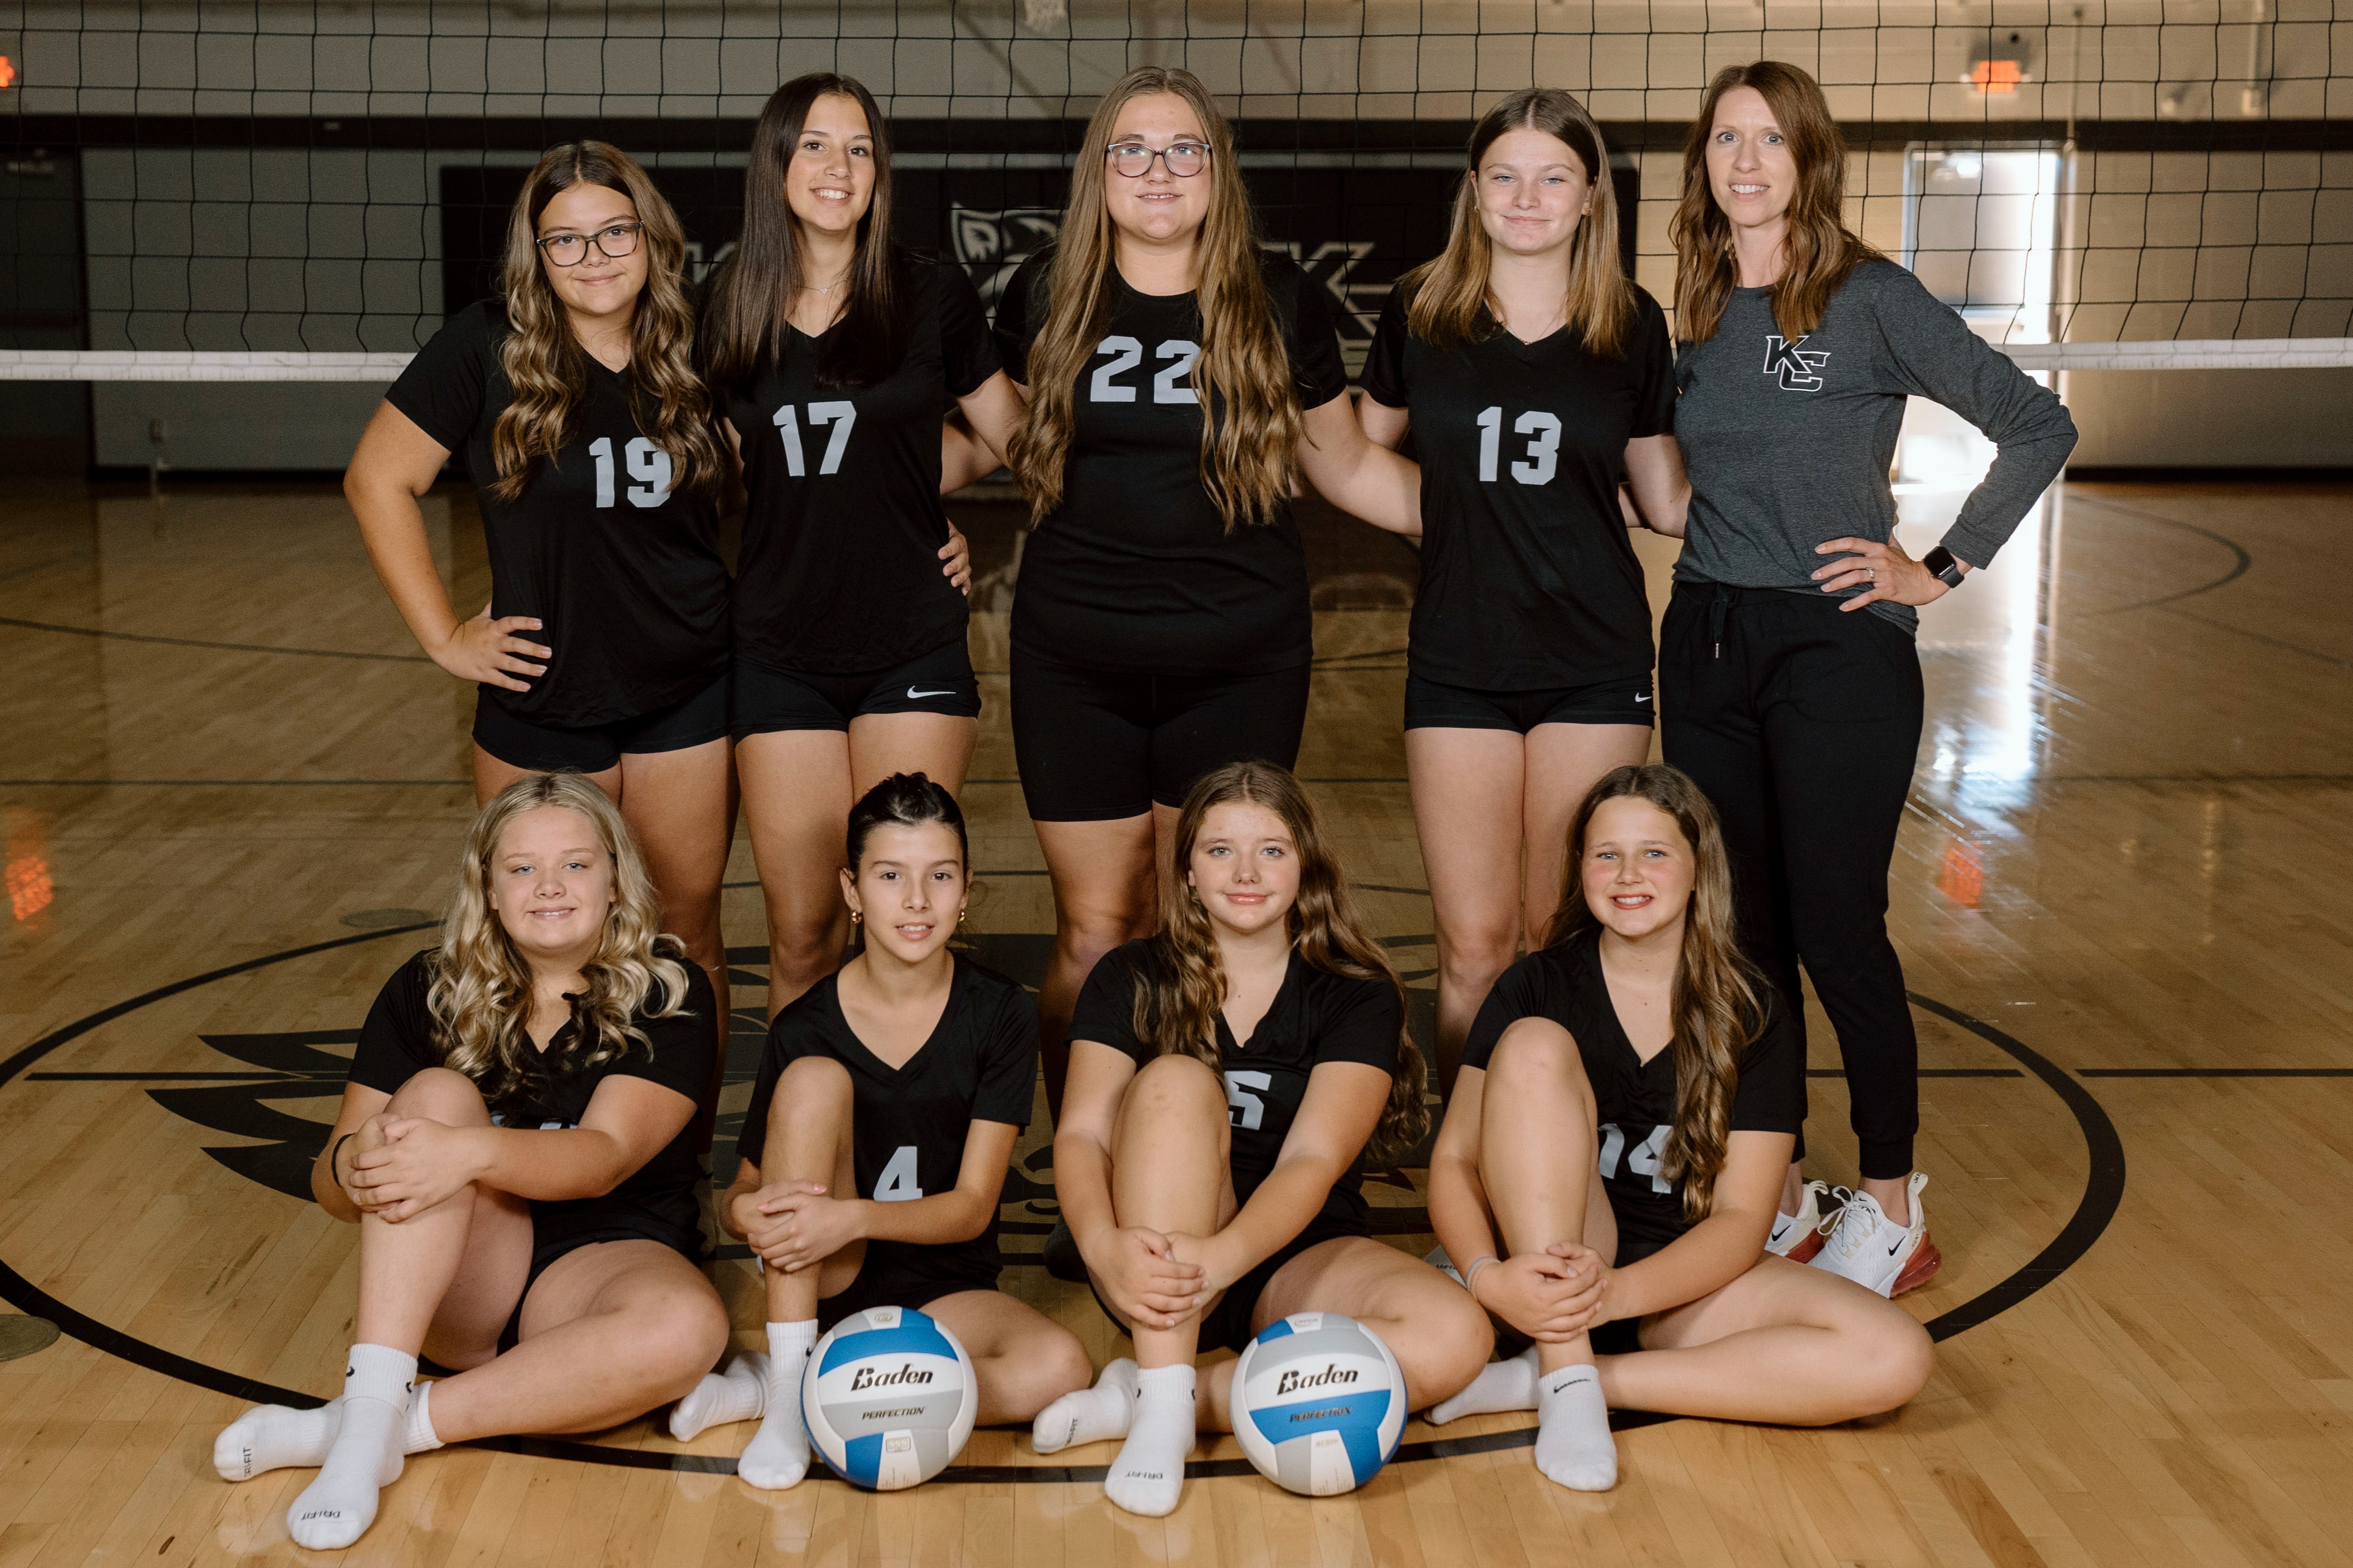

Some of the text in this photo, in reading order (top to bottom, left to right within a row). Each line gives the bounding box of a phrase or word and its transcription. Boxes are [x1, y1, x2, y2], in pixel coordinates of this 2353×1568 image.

[1090, 335, 1202, 404] 22
[1763, 335, 1832, 392] KC
[772, 401, 857, 477] 17
[1477, 406, 1562, 485] 13
[589, 437, 672, 508] 19
[1224, 1070, 1272, 1131] 5
[873, 1145, 923, 1202] 4
[1597, 1123, 1674, 1194] 14
[850, 1362, 933, 1391] Baden
[1277, 1363, 1358, 1396] Baden
[862, 1406, 925, 1420] PERFECTION
[1289, 1407, 1352, 1423] PERFECTION
